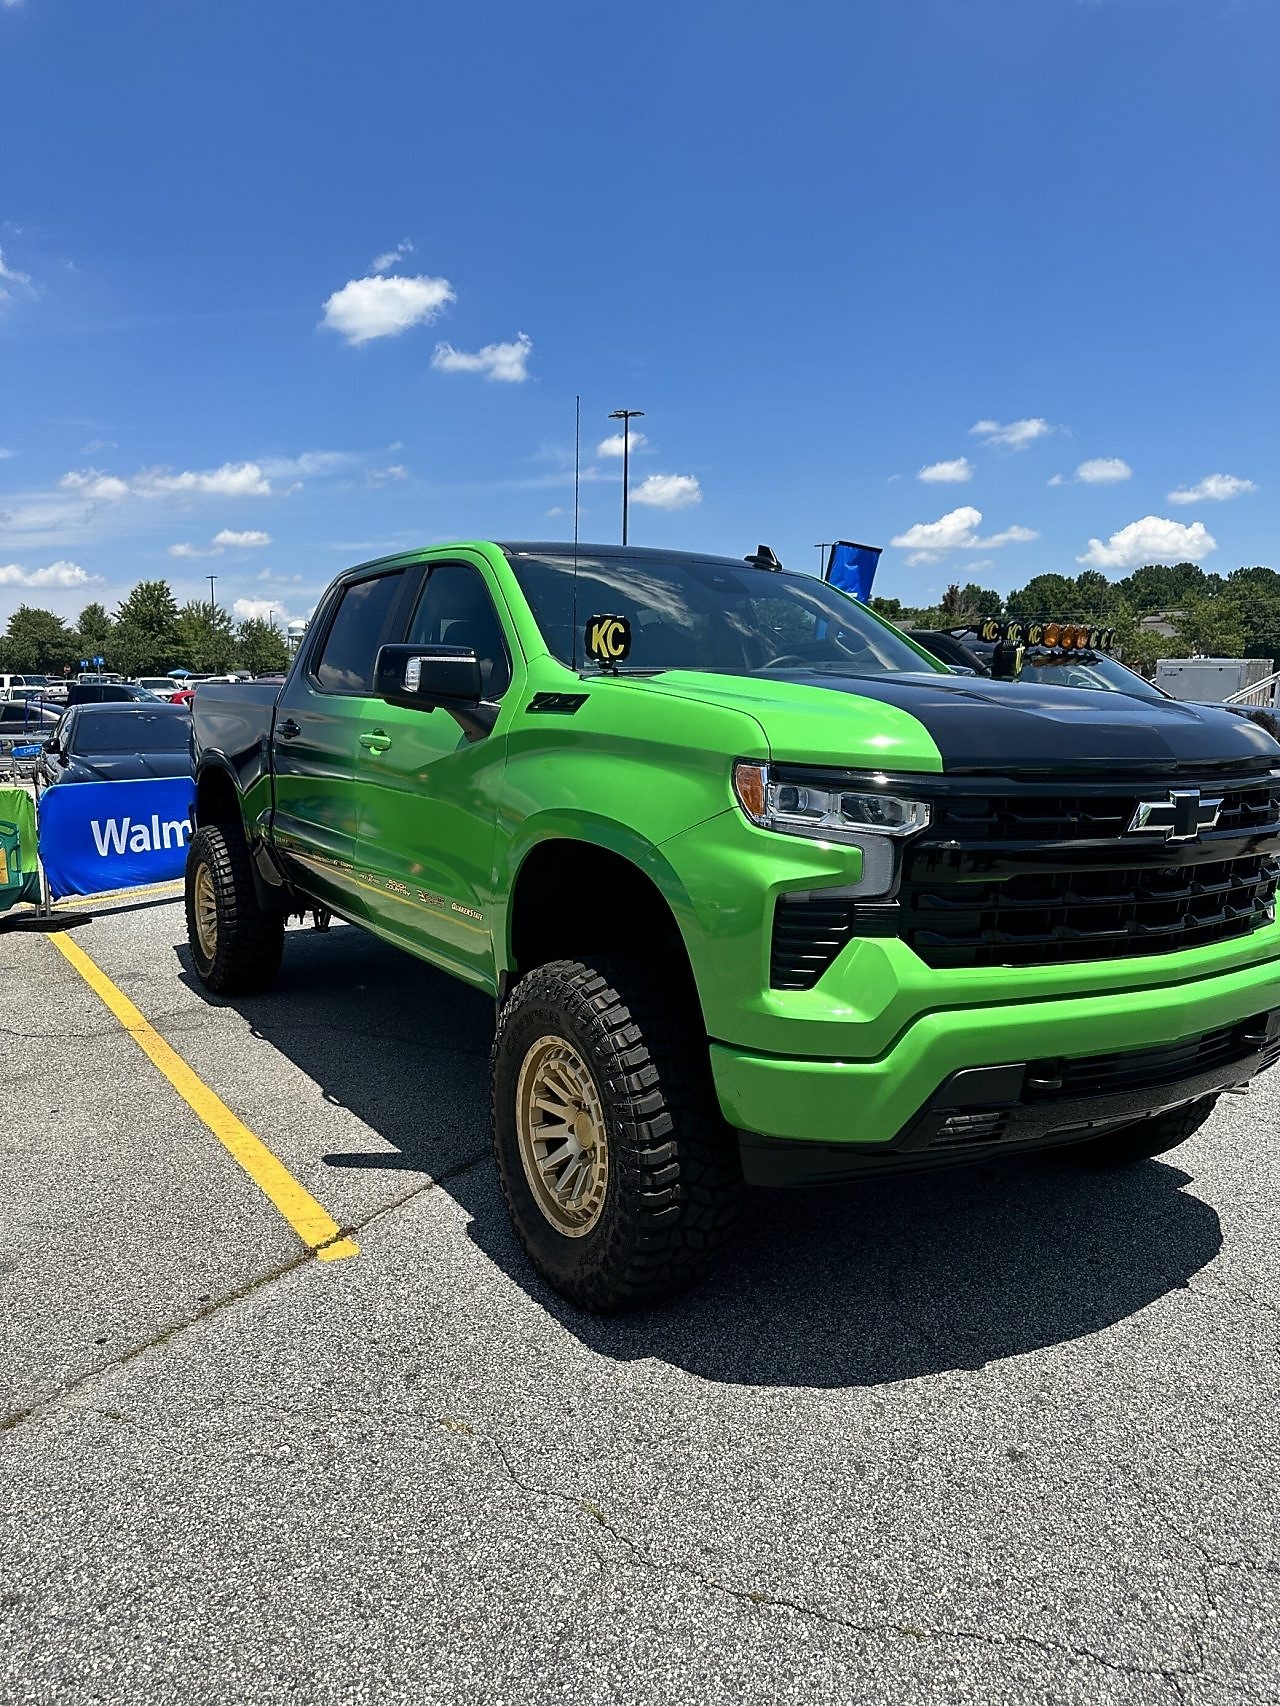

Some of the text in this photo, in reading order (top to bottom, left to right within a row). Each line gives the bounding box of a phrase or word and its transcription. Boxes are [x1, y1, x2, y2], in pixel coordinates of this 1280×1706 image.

[591, 619, 625, 658] KC
[982, 620, 999, 640] KC
[1007, 623, 1022, 640] KC
[1028, 625, 1042, 645] KC
[385, 883, 411, 897] COUNTRY
